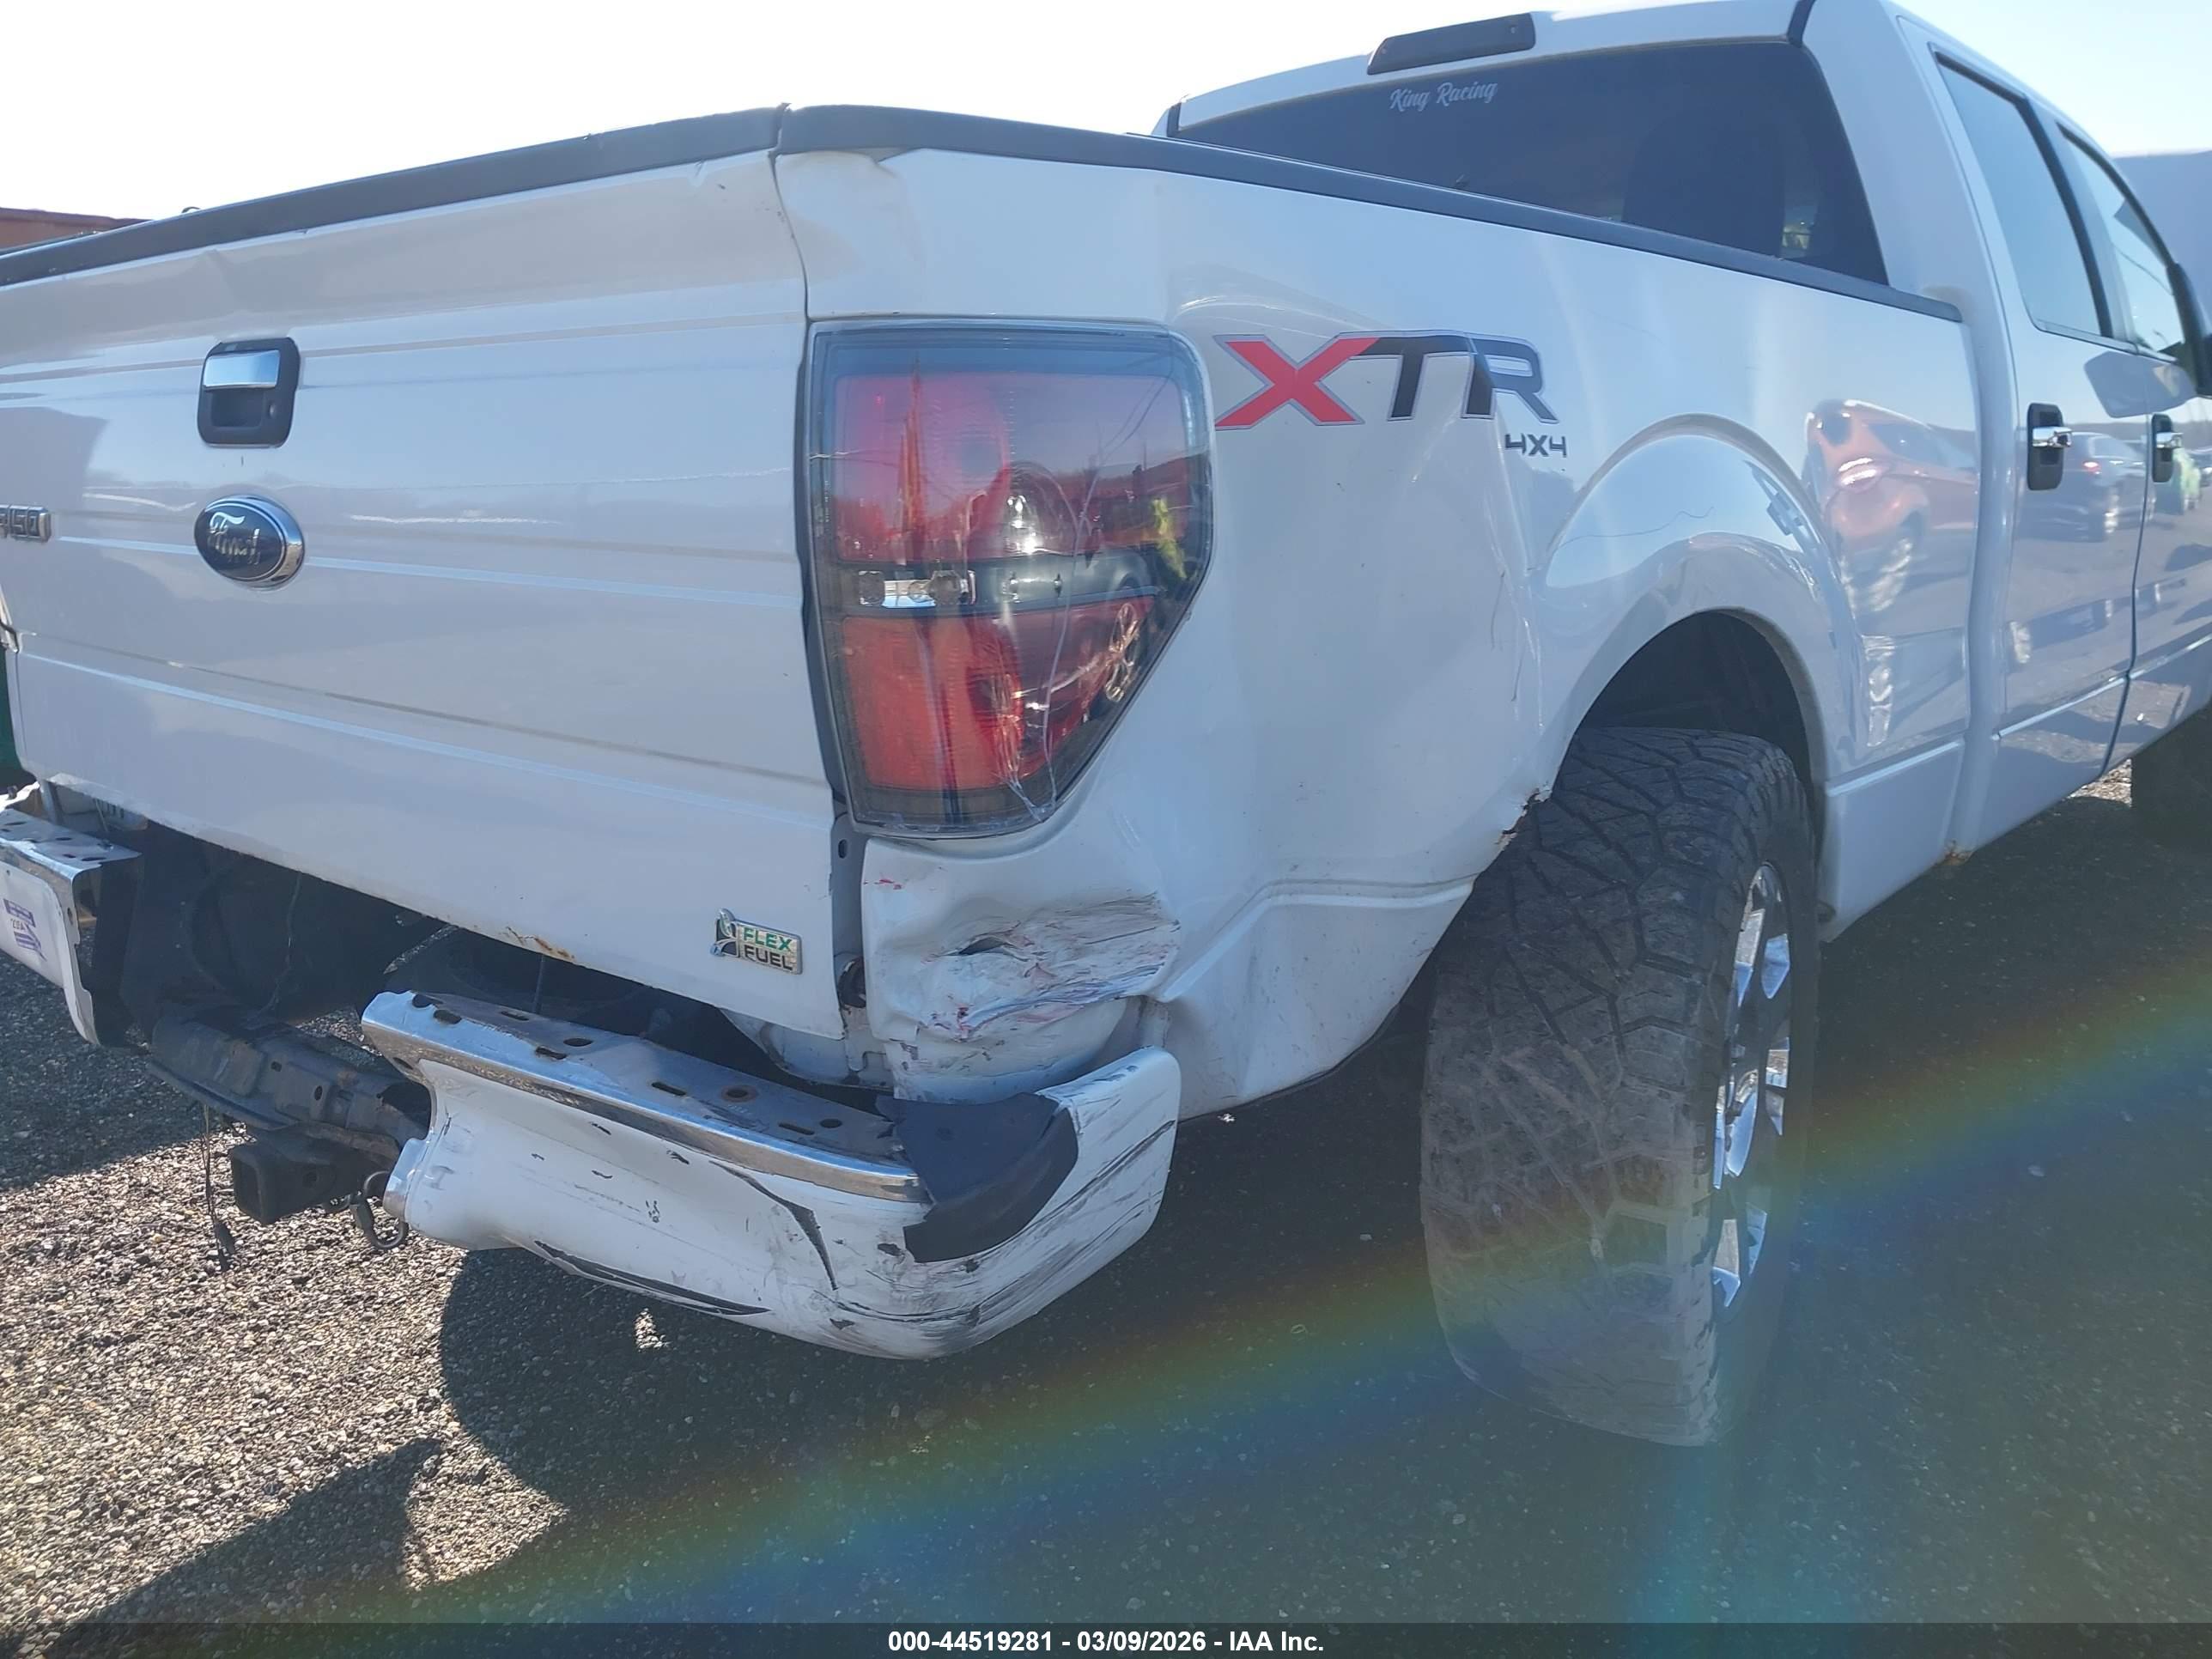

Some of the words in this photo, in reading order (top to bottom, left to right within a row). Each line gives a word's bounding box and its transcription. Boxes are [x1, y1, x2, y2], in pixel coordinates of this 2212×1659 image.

[1389, 88, 1431, 112] King
[1437, 81, 1498, 106] Racing
[1212, 330, 1559, 430] XTR
[743, 927, 792, 951] FLEX
[744, 944, 793, 970] FUEL
